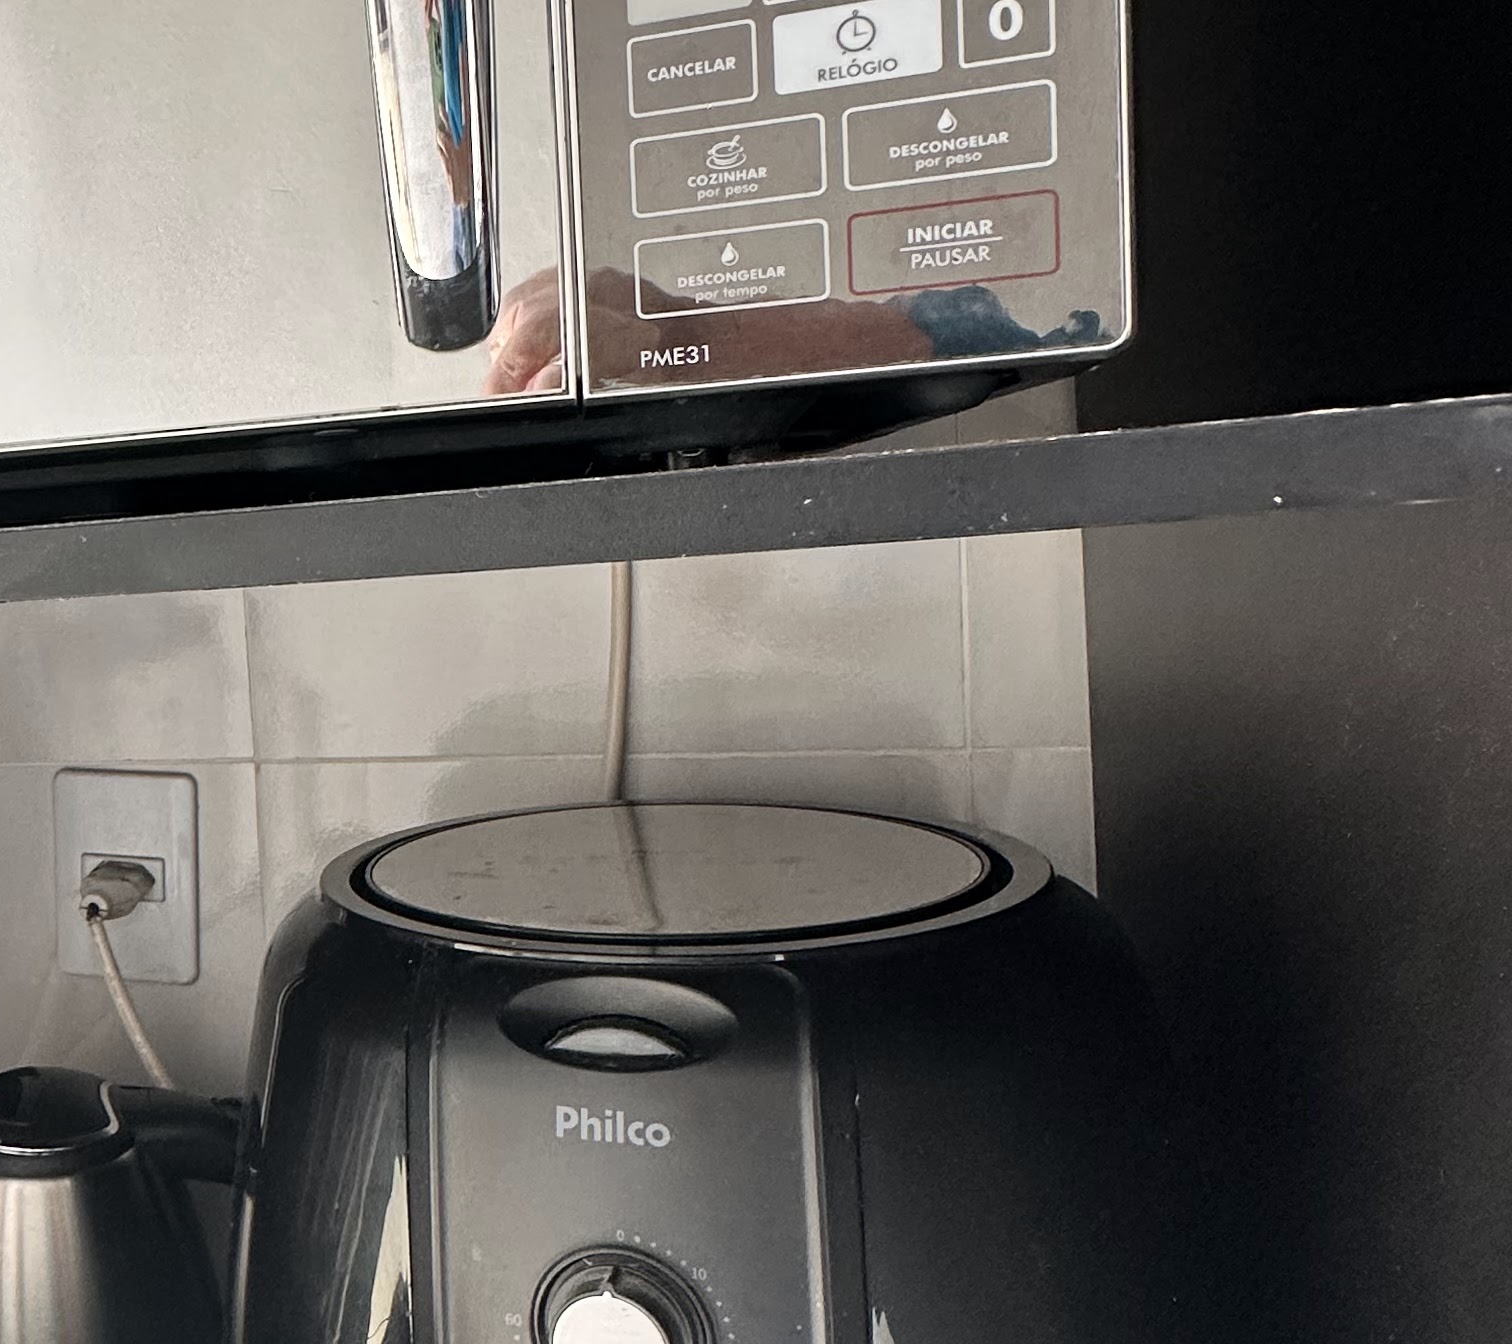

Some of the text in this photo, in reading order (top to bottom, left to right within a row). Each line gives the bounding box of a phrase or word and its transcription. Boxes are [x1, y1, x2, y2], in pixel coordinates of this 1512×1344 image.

[646, 56, 737, 83] CANCELAR
[816, 56, 899, 83] RELÓGIO
[888, 130, 1010, 160] DESCONGELAR
[914, 151, 983, 172] por peso
[687, 166, 768, 188] COZINHAR
[696, 182, 759, 202] por peso
[905, 218, 994, 244] INICIAR
[909, 245, 992, 270] PAUSAR
[676, 265, 786, 288] DESCONGELAR
[694, 284, 768, 304] por tempo
[639, 344, 711, 369] PME31
[554, 1104, 671, 1148] Philco
[616, 1230, 625, 1241] 0
[691, 1267, 707, 1280] 10
[505, 1313, 522, 1327] 60
